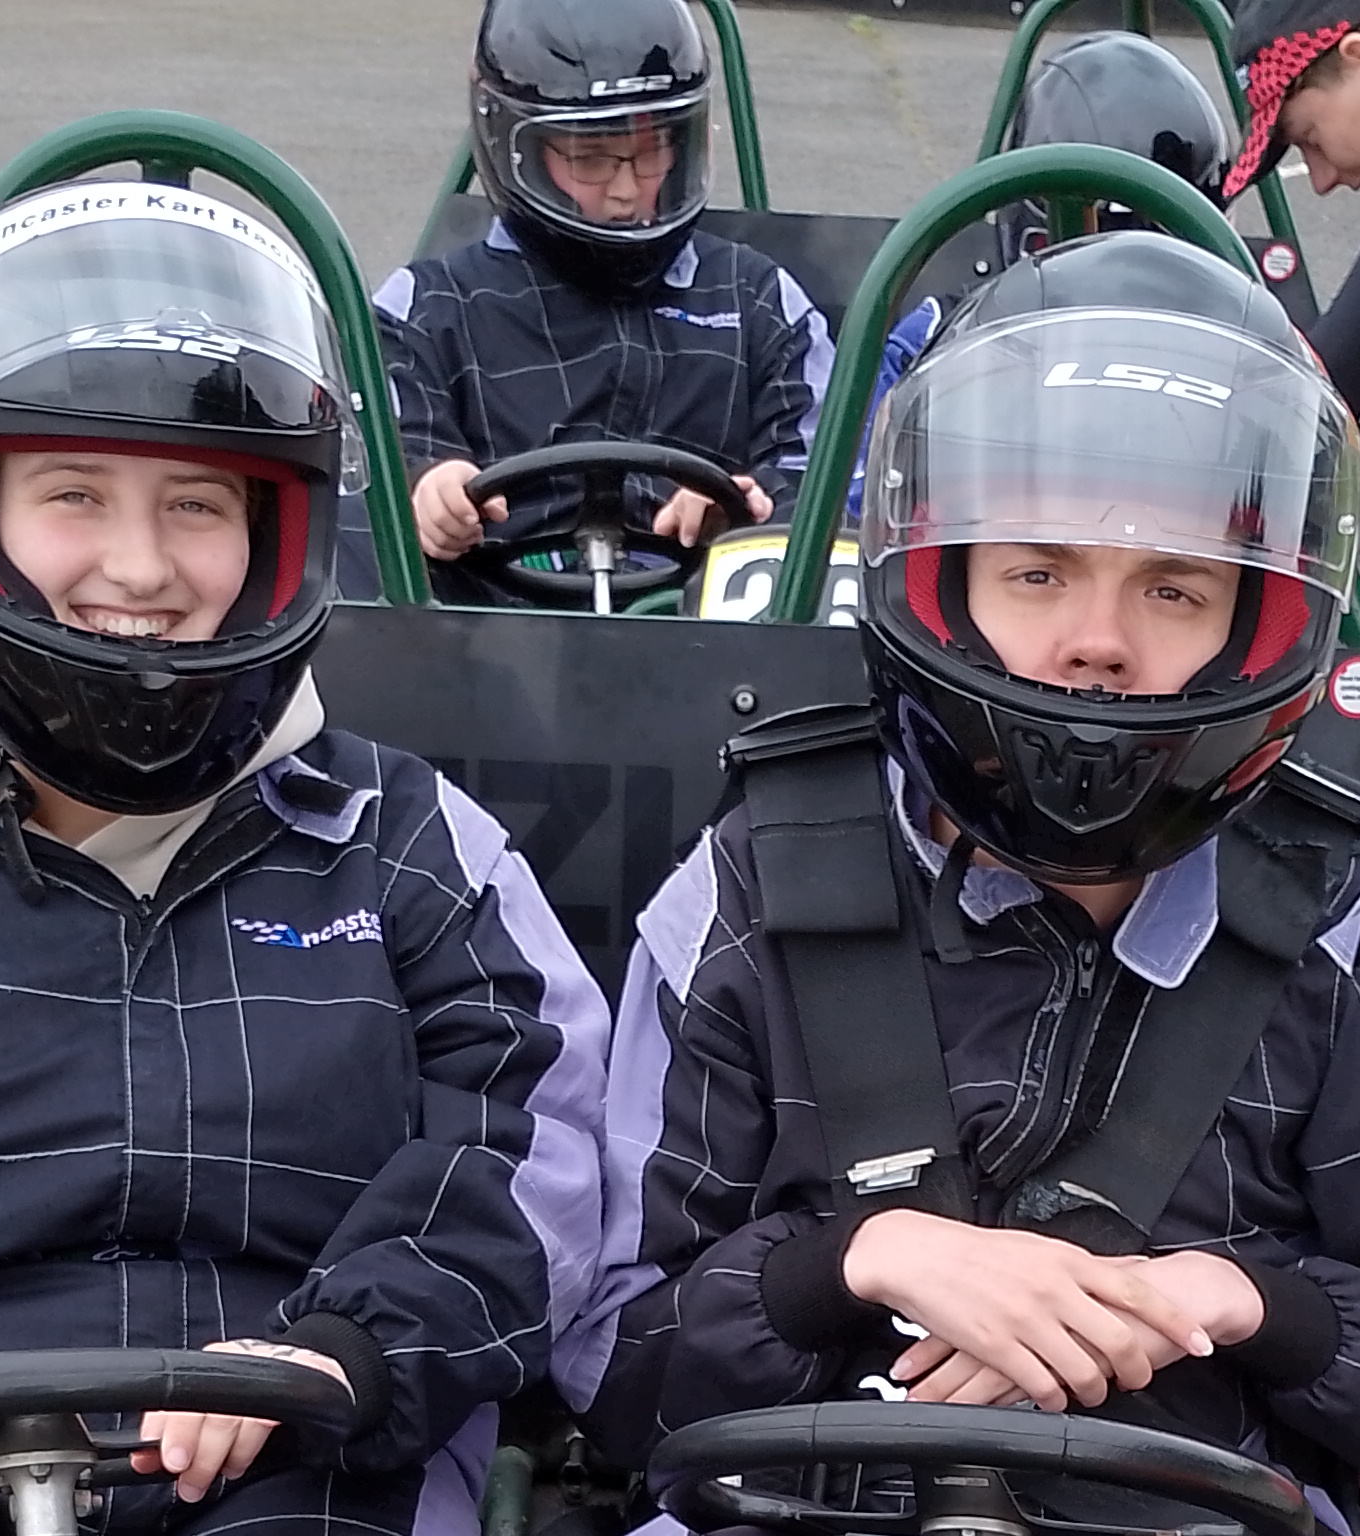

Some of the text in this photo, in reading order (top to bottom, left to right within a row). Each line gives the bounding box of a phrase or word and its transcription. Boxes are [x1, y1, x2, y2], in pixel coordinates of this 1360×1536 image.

[589, 75, 673, 97] LS2
[146, 194, 216, 221] Kart
[1043, 361, 1232, 409] LS2
